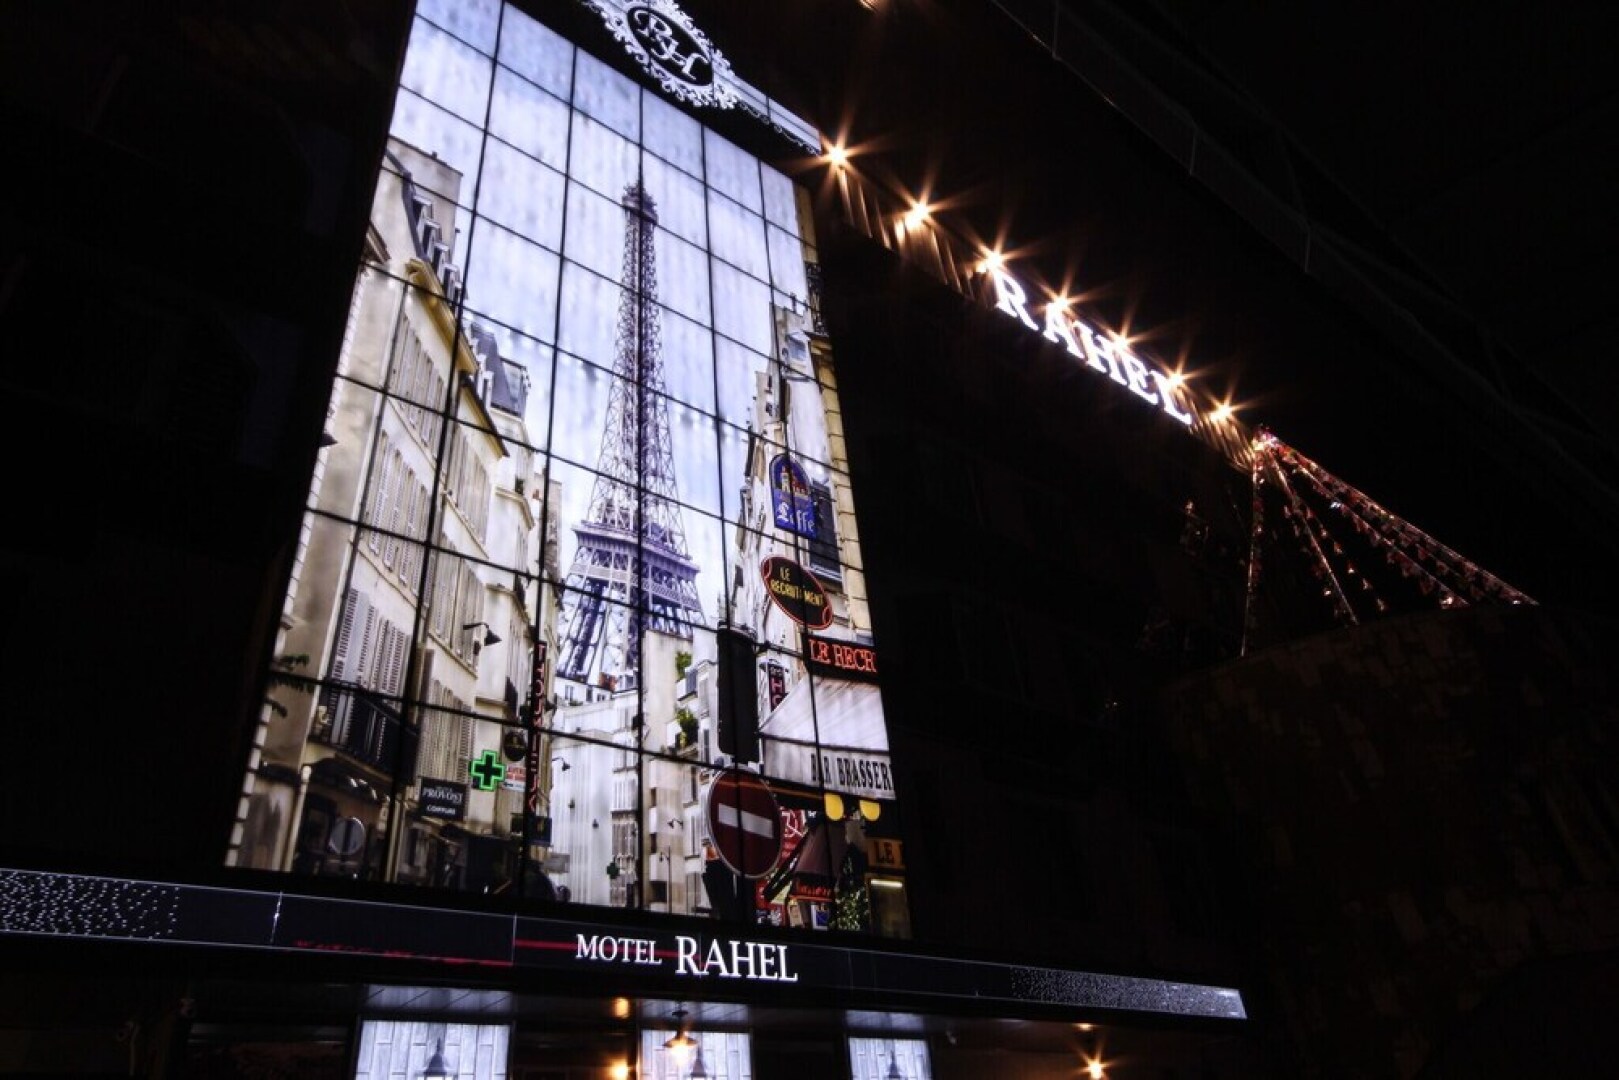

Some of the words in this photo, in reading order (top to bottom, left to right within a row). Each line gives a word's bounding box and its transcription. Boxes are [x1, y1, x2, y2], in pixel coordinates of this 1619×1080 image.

[993, 266, 1193, 425] RAHEL
[809, 639, 832, 665] LE
[575, 933, 663, 966] MOTEL
[674, 935, 799, 983] RAHEL
